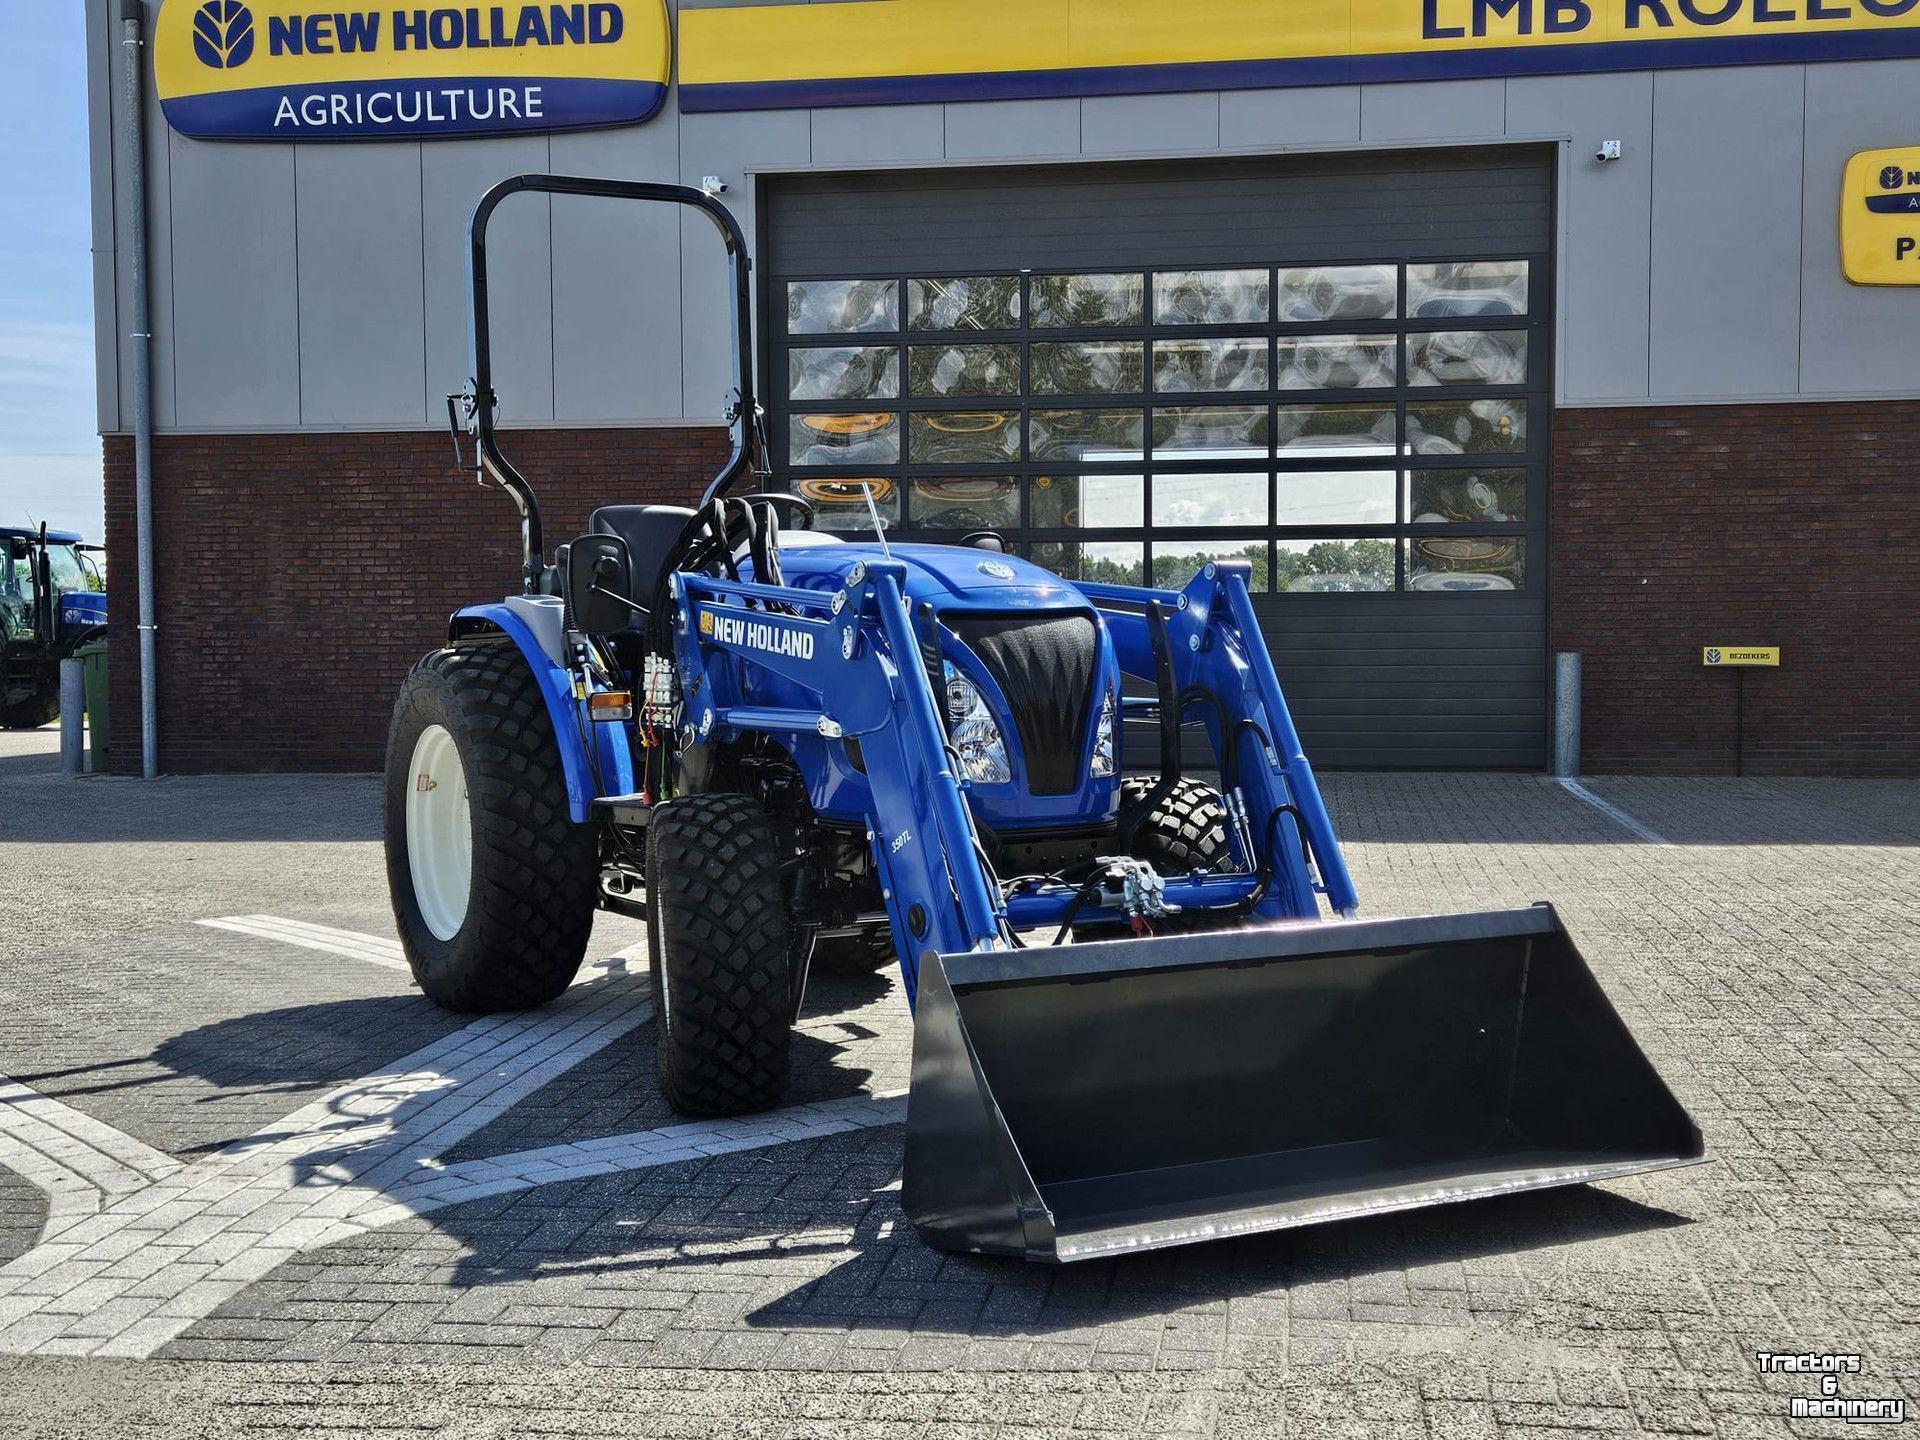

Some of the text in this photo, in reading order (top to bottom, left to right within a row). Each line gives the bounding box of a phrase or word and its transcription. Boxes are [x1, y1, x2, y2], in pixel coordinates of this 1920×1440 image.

[269, 3, 624, 56] NEW HOLLAND
[274, 87, 544, 126] AGRICULTURE
[714, 616, 745, 645] NEW
[747, 622, 814, 660] HOLLAND
